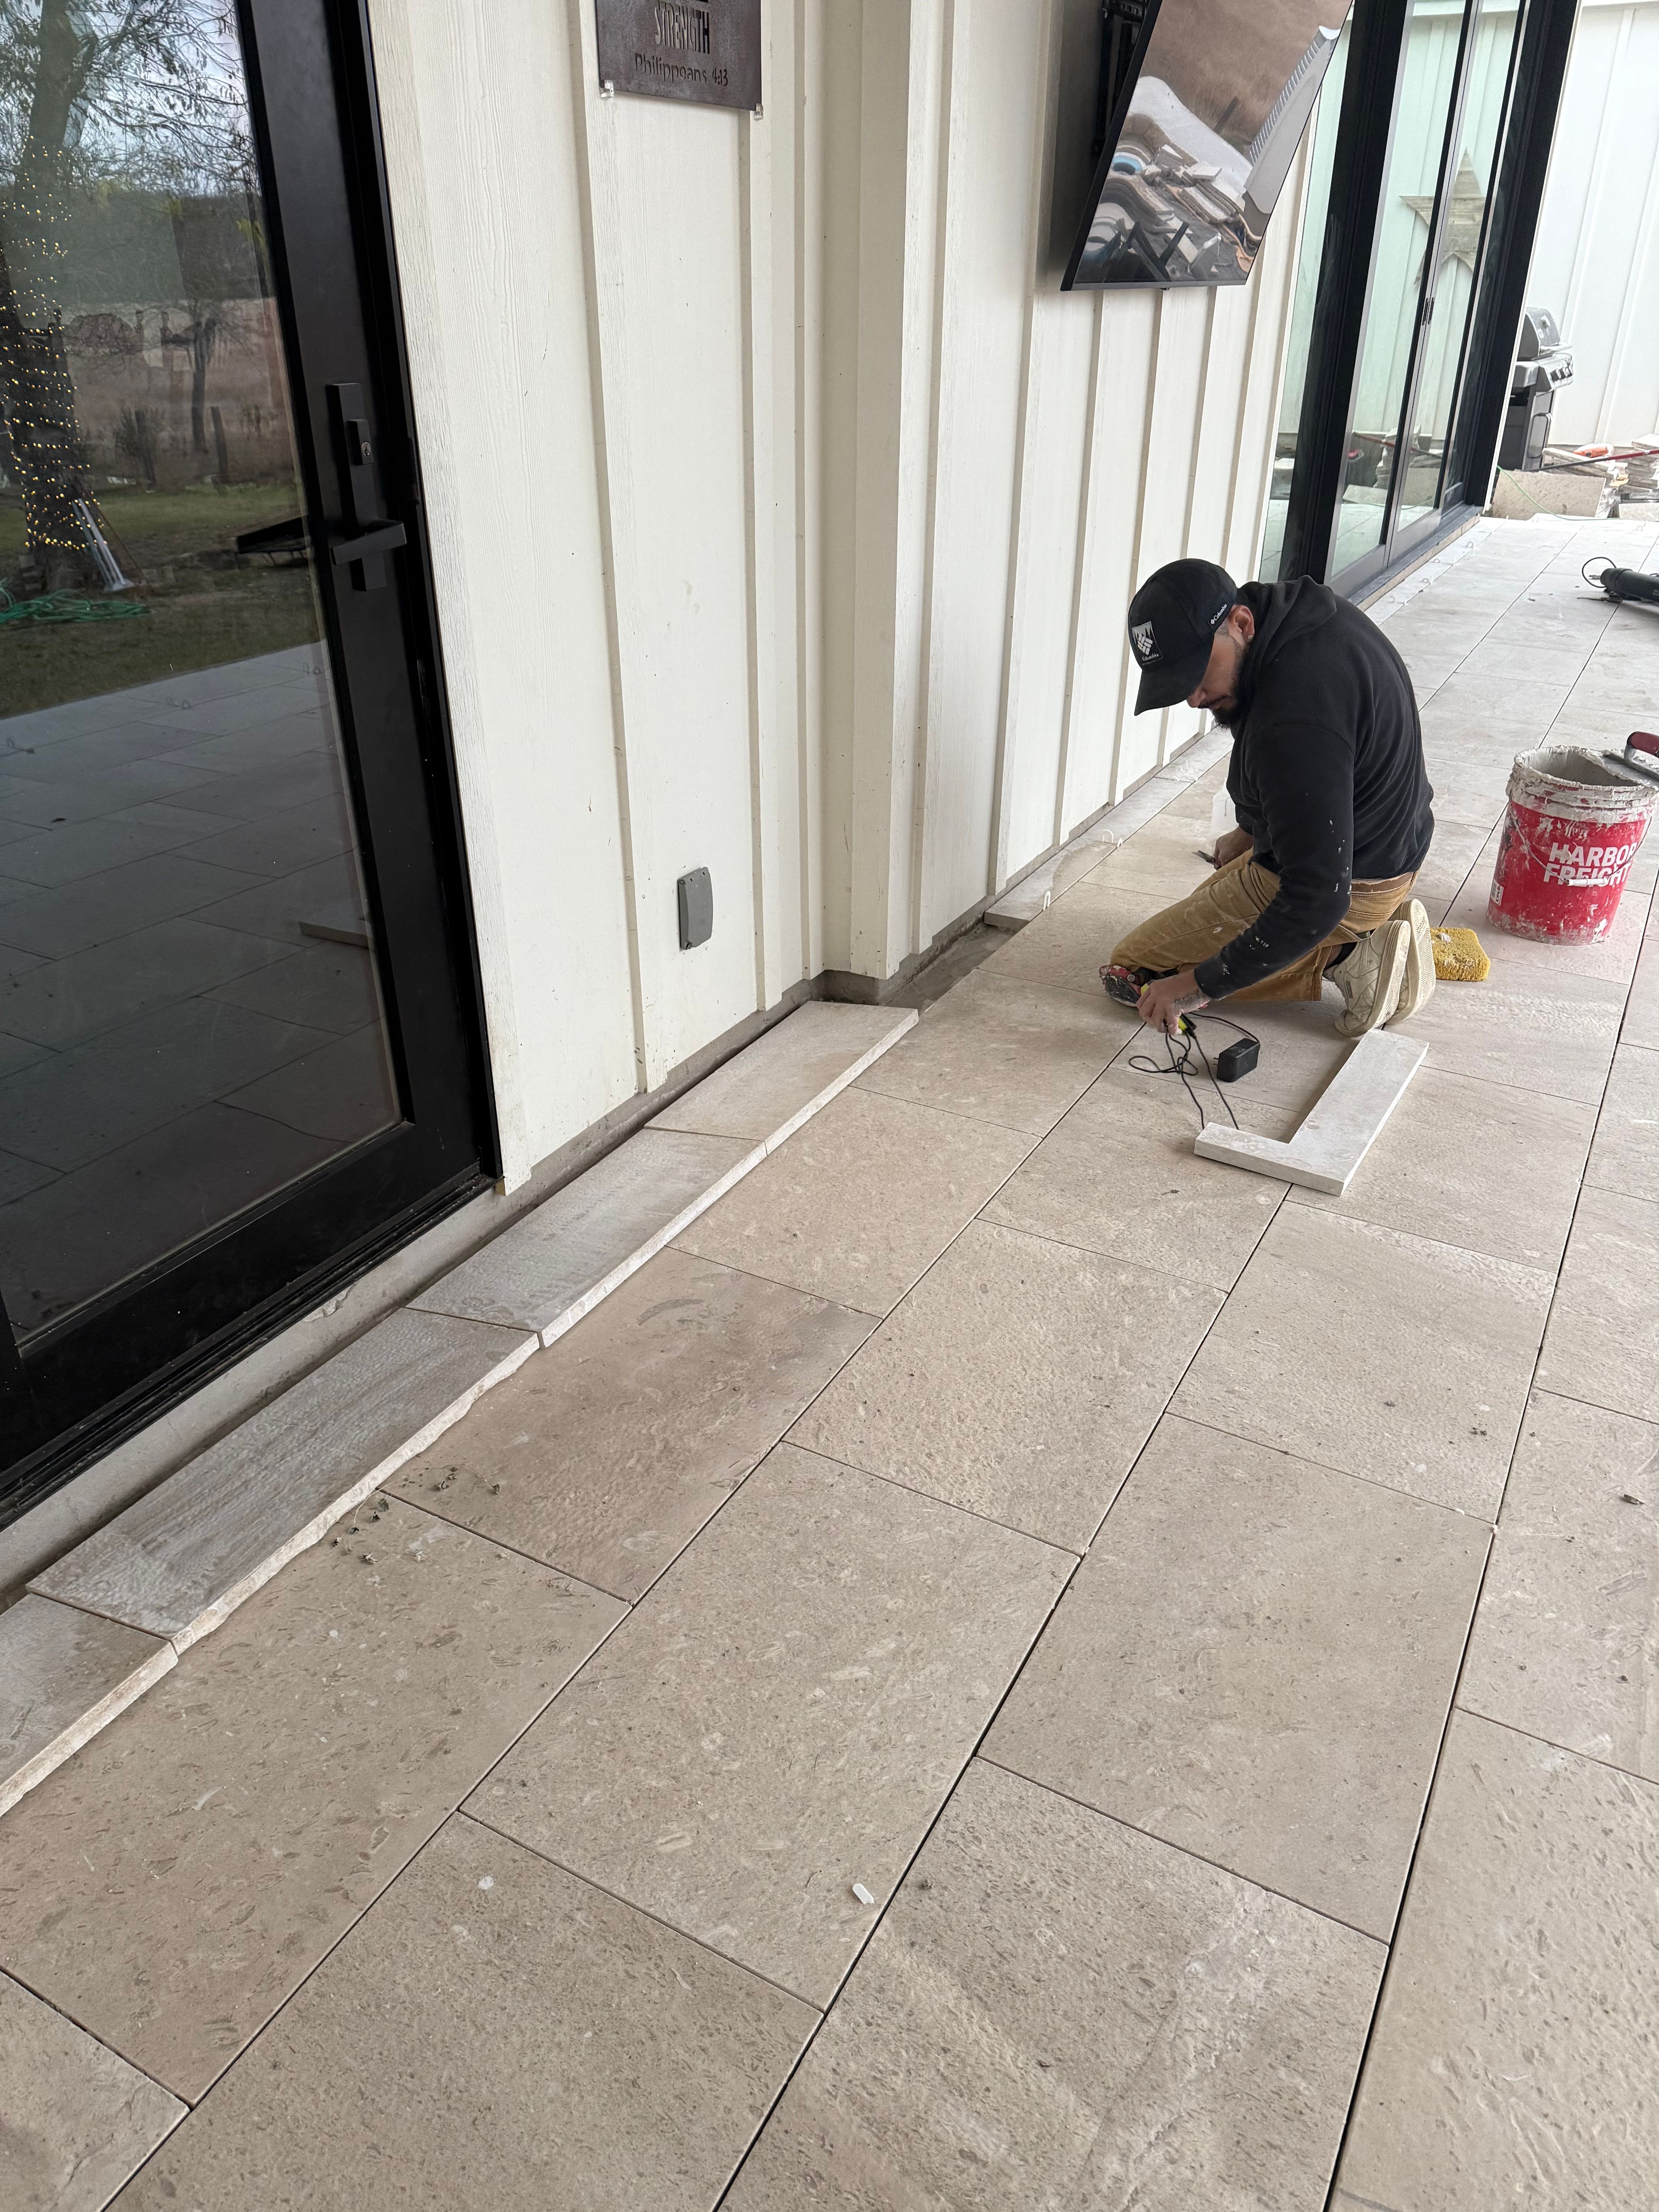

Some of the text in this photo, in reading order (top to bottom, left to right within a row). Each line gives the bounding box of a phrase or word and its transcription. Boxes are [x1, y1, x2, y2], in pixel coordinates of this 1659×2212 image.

[654, 0, 709, 54] STRENGTH
[712, 68, 728, 86] 4:13
[1214, 604, 1227, 621] Columbia
[1549, 842, 1637, 867] HARBOR
[1544, 862, 1632, 887] FREIGHT
